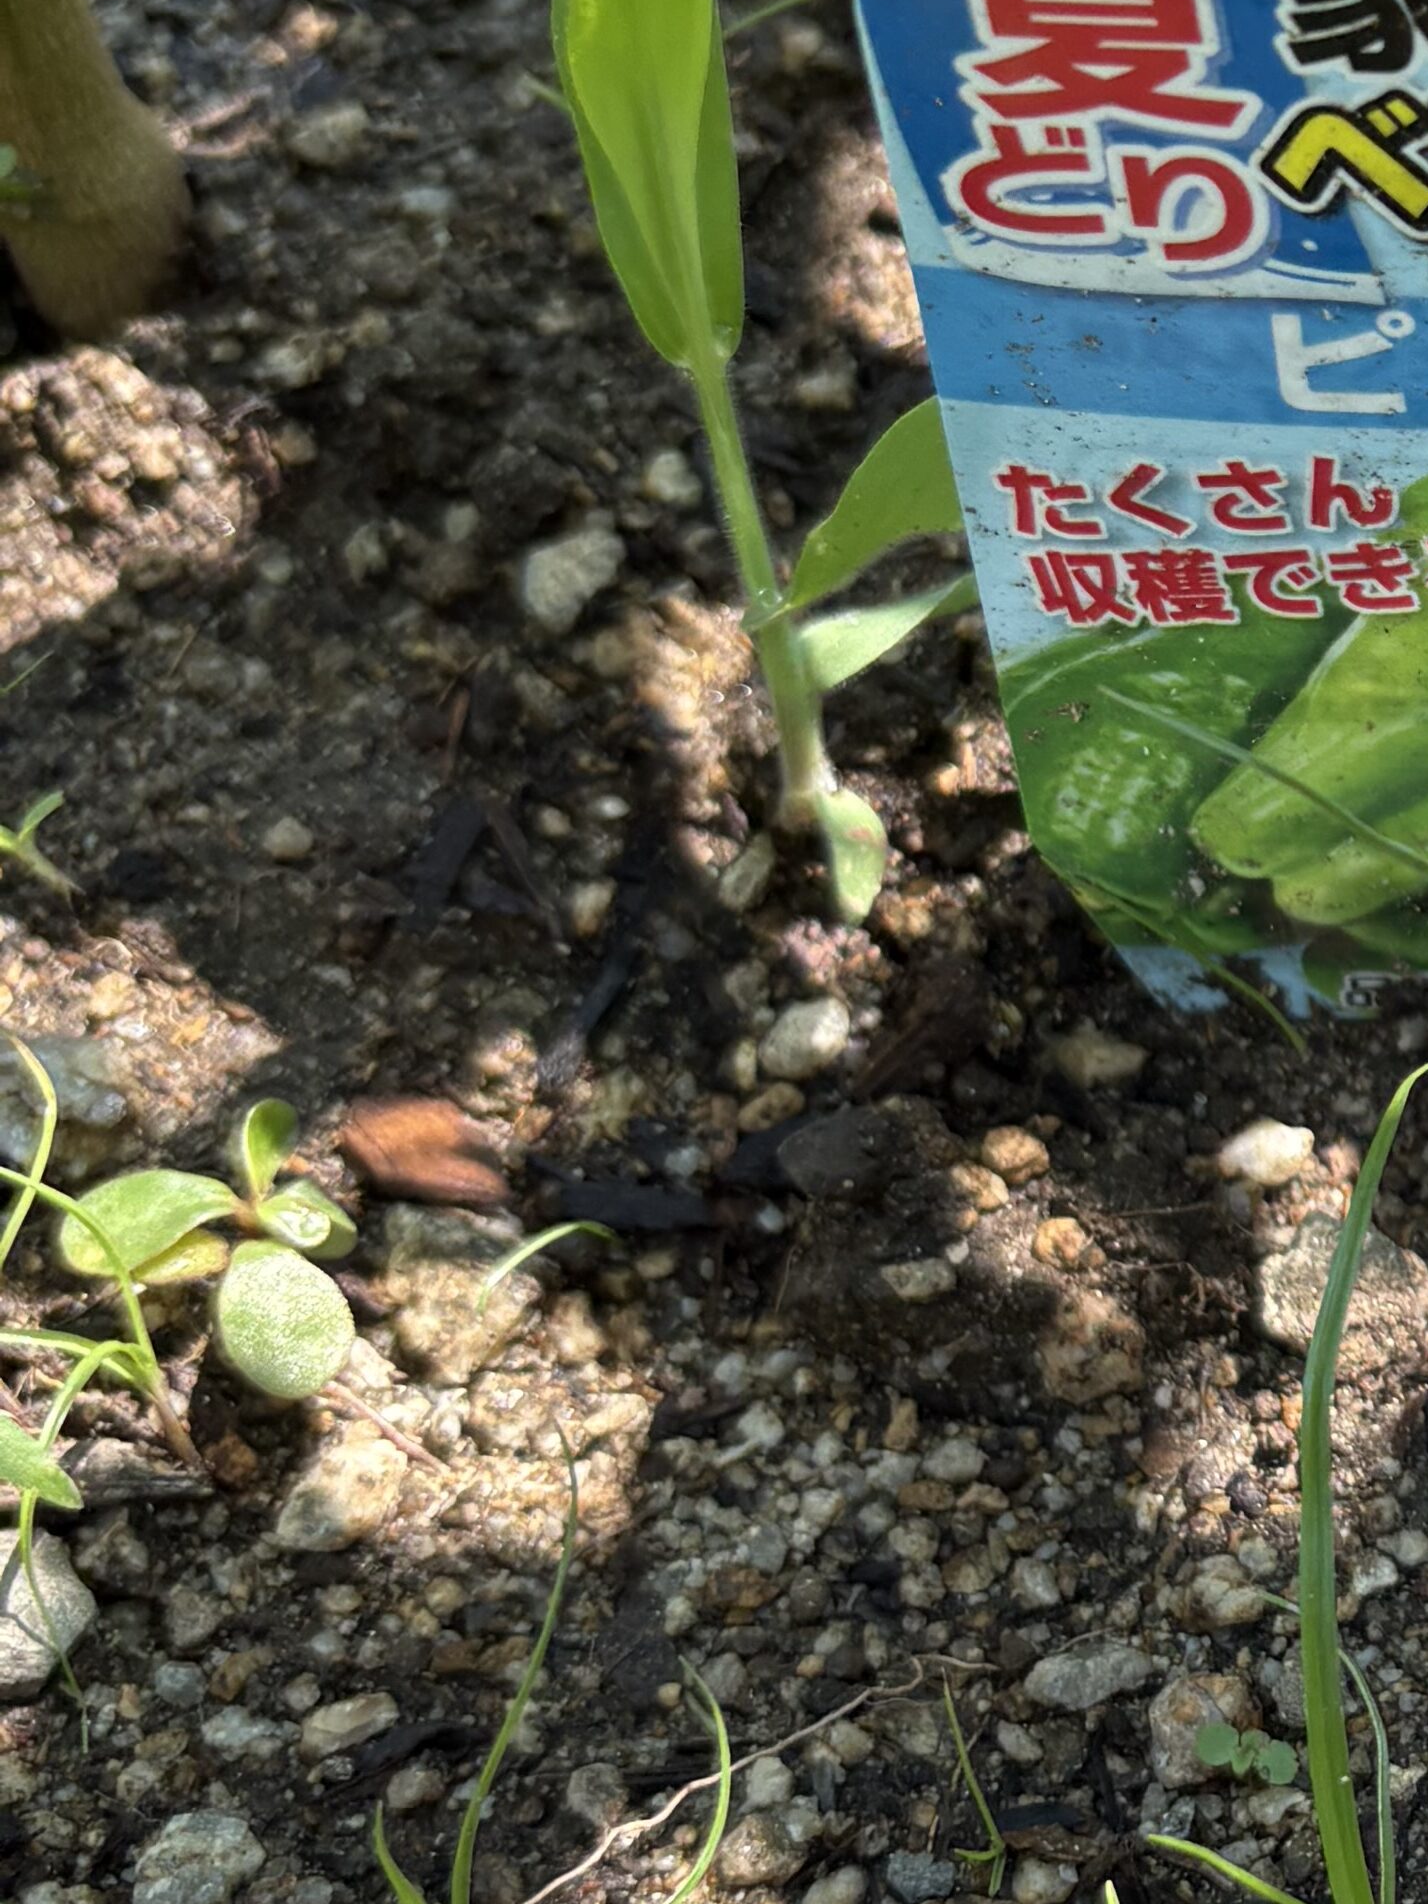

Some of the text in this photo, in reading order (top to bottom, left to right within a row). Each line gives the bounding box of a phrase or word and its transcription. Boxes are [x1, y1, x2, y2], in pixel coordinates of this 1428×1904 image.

[960, 123, 1255, 263] どり
[998, 455, 1394, 537] たくさん
